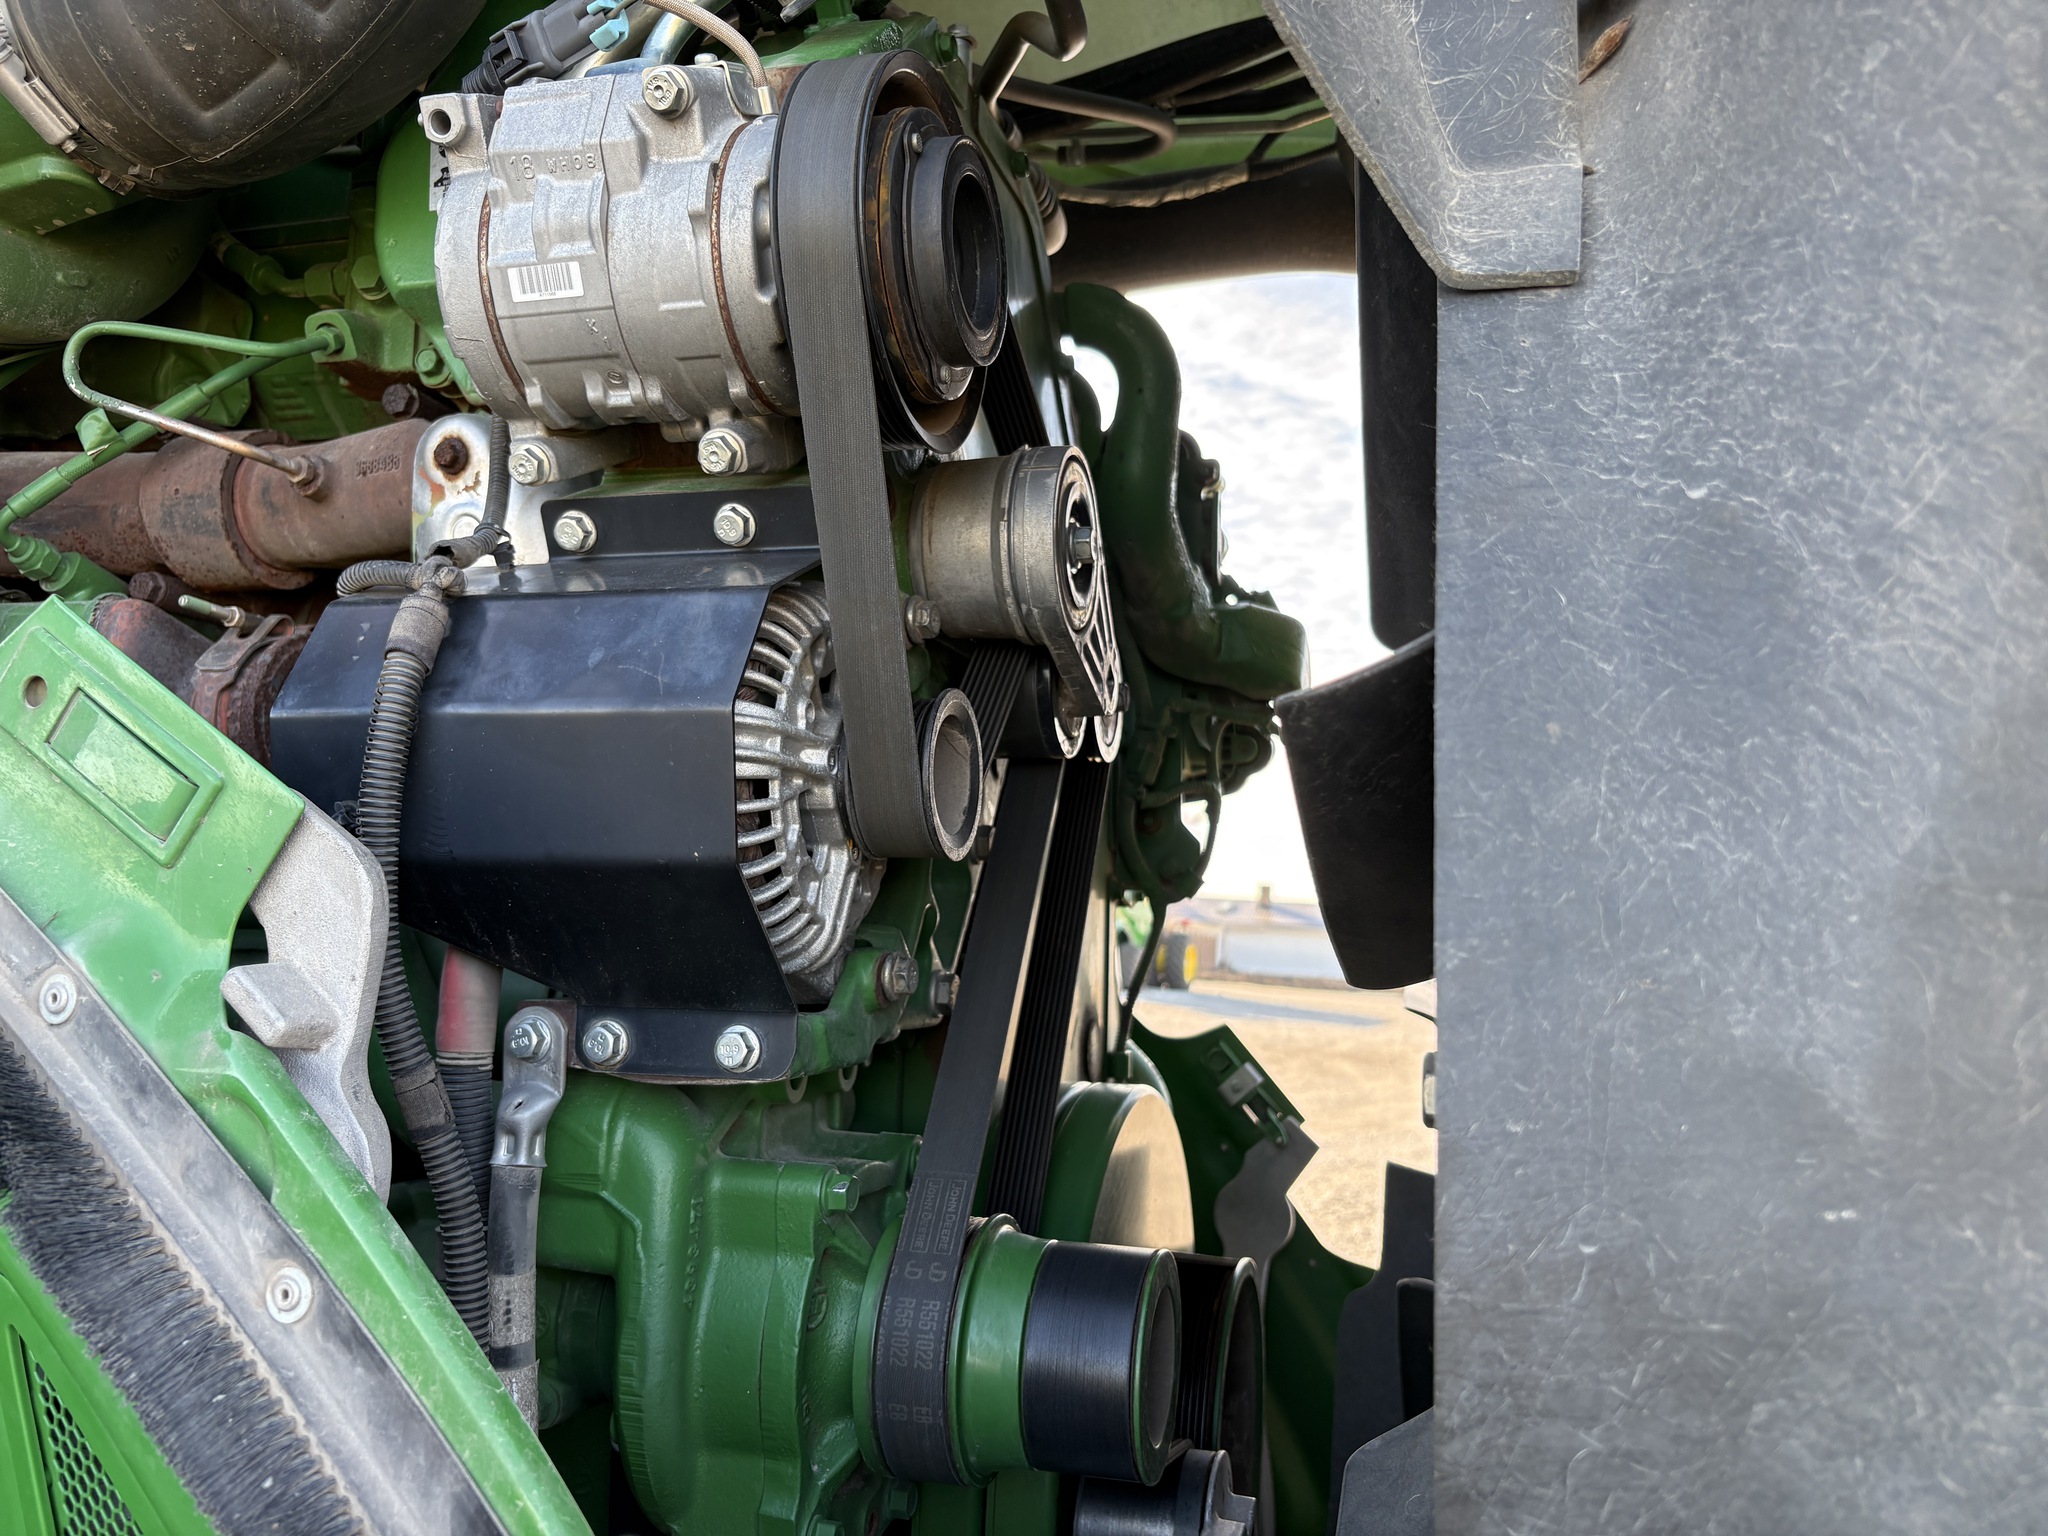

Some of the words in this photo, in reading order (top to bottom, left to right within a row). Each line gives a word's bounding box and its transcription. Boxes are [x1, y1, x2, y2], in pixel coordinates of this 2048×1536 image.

[509, 154, 536, 182] 18
[720, 1044, 740, 1056] 10.9
[889, 1297, 916, 1367] R551022
[913, 1299, 941, 1370] R551022
